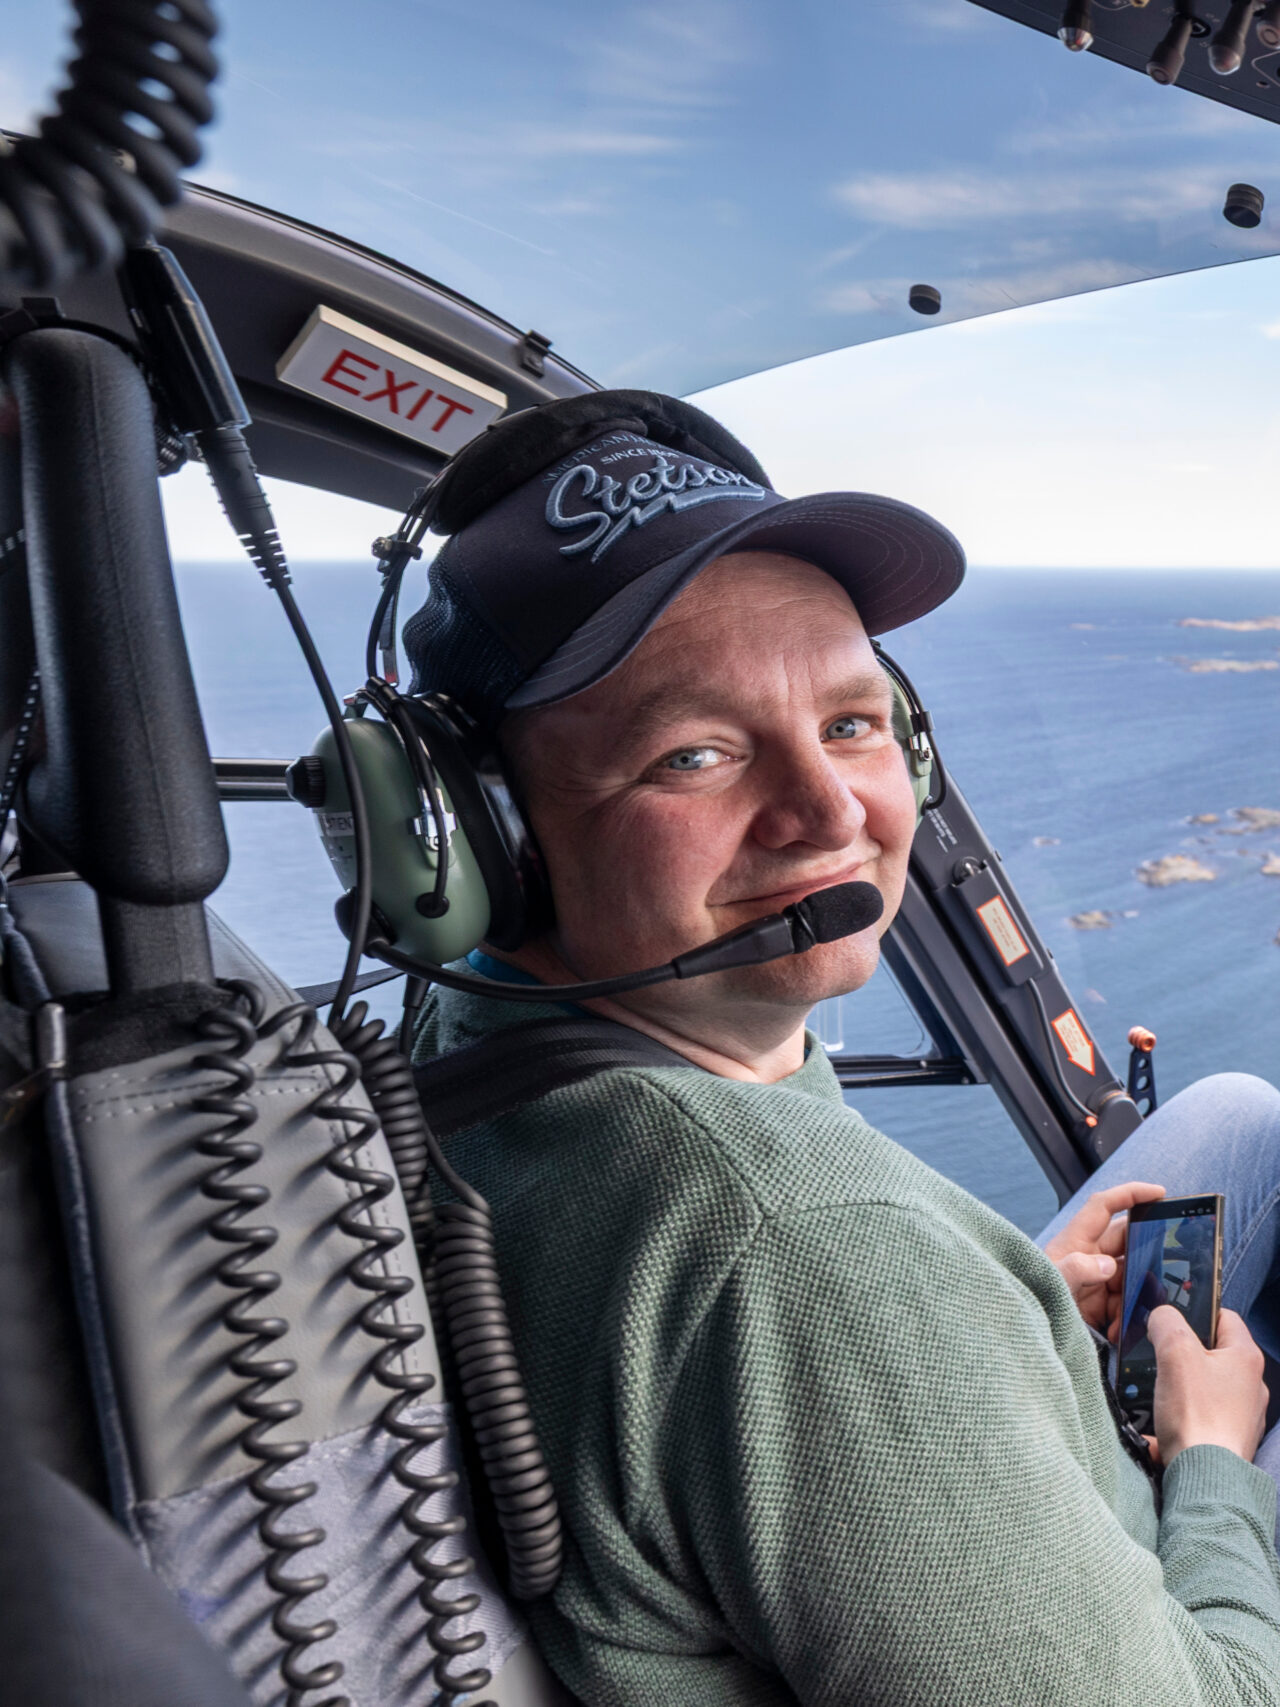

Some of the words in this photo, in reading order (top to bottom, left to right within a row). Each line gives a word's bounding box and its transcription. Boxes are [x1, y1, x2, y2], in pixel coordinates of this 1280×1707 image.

[320, 349, 475, 433] EXIT
[601, 449, 647, 465] SINCE
[545, 455, 765, 556] Stetson
